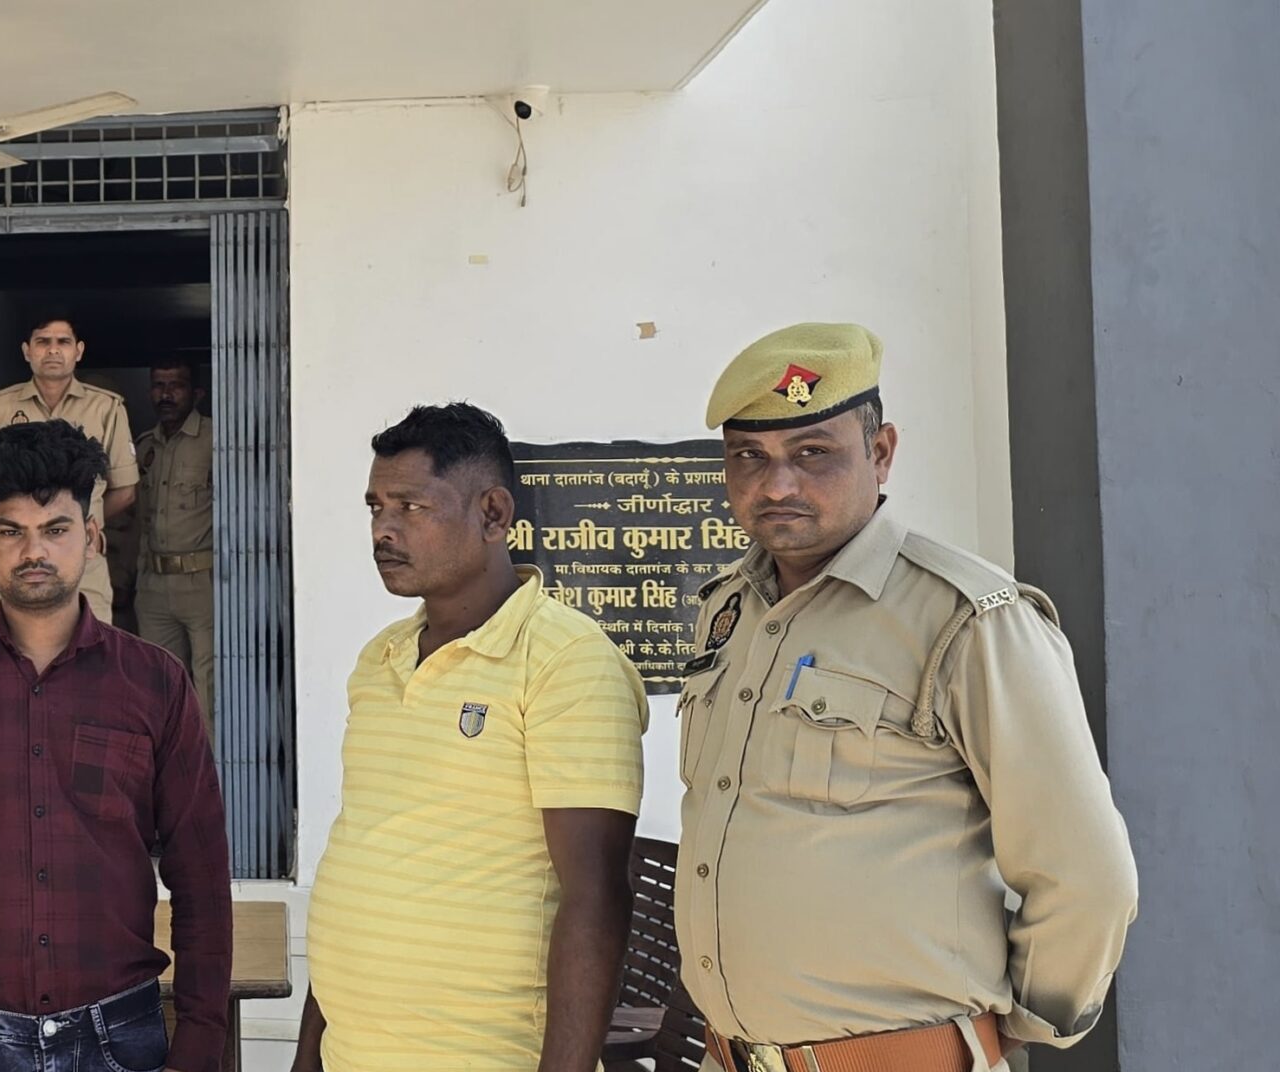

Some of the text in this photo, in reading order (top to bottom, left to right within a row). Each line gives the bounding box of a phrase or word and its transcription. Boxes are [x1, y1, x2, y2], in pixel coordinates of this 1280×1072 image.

[520, 472, 550, 487] थाना
[554, 470, 605, 487] दातागंज
[664, 468, 680, 485] के
[541, 519, 616, 551] राजीव
[622, 526, 693, 559] कुमार
[700, 517, 752, 551] सिंह
[625, 561, 672, 575] दातागंज
[675, 560, 689, 574] के
[692, 563, 713, 574] कर
[587, 586, 638, 615] कुमार
[642, 579, 677, 608] सिंह
[598, 620, 629, 633] स्थिति
[632, 619, 645, 633] में
[646, 619, 684, 633] दिनांक
